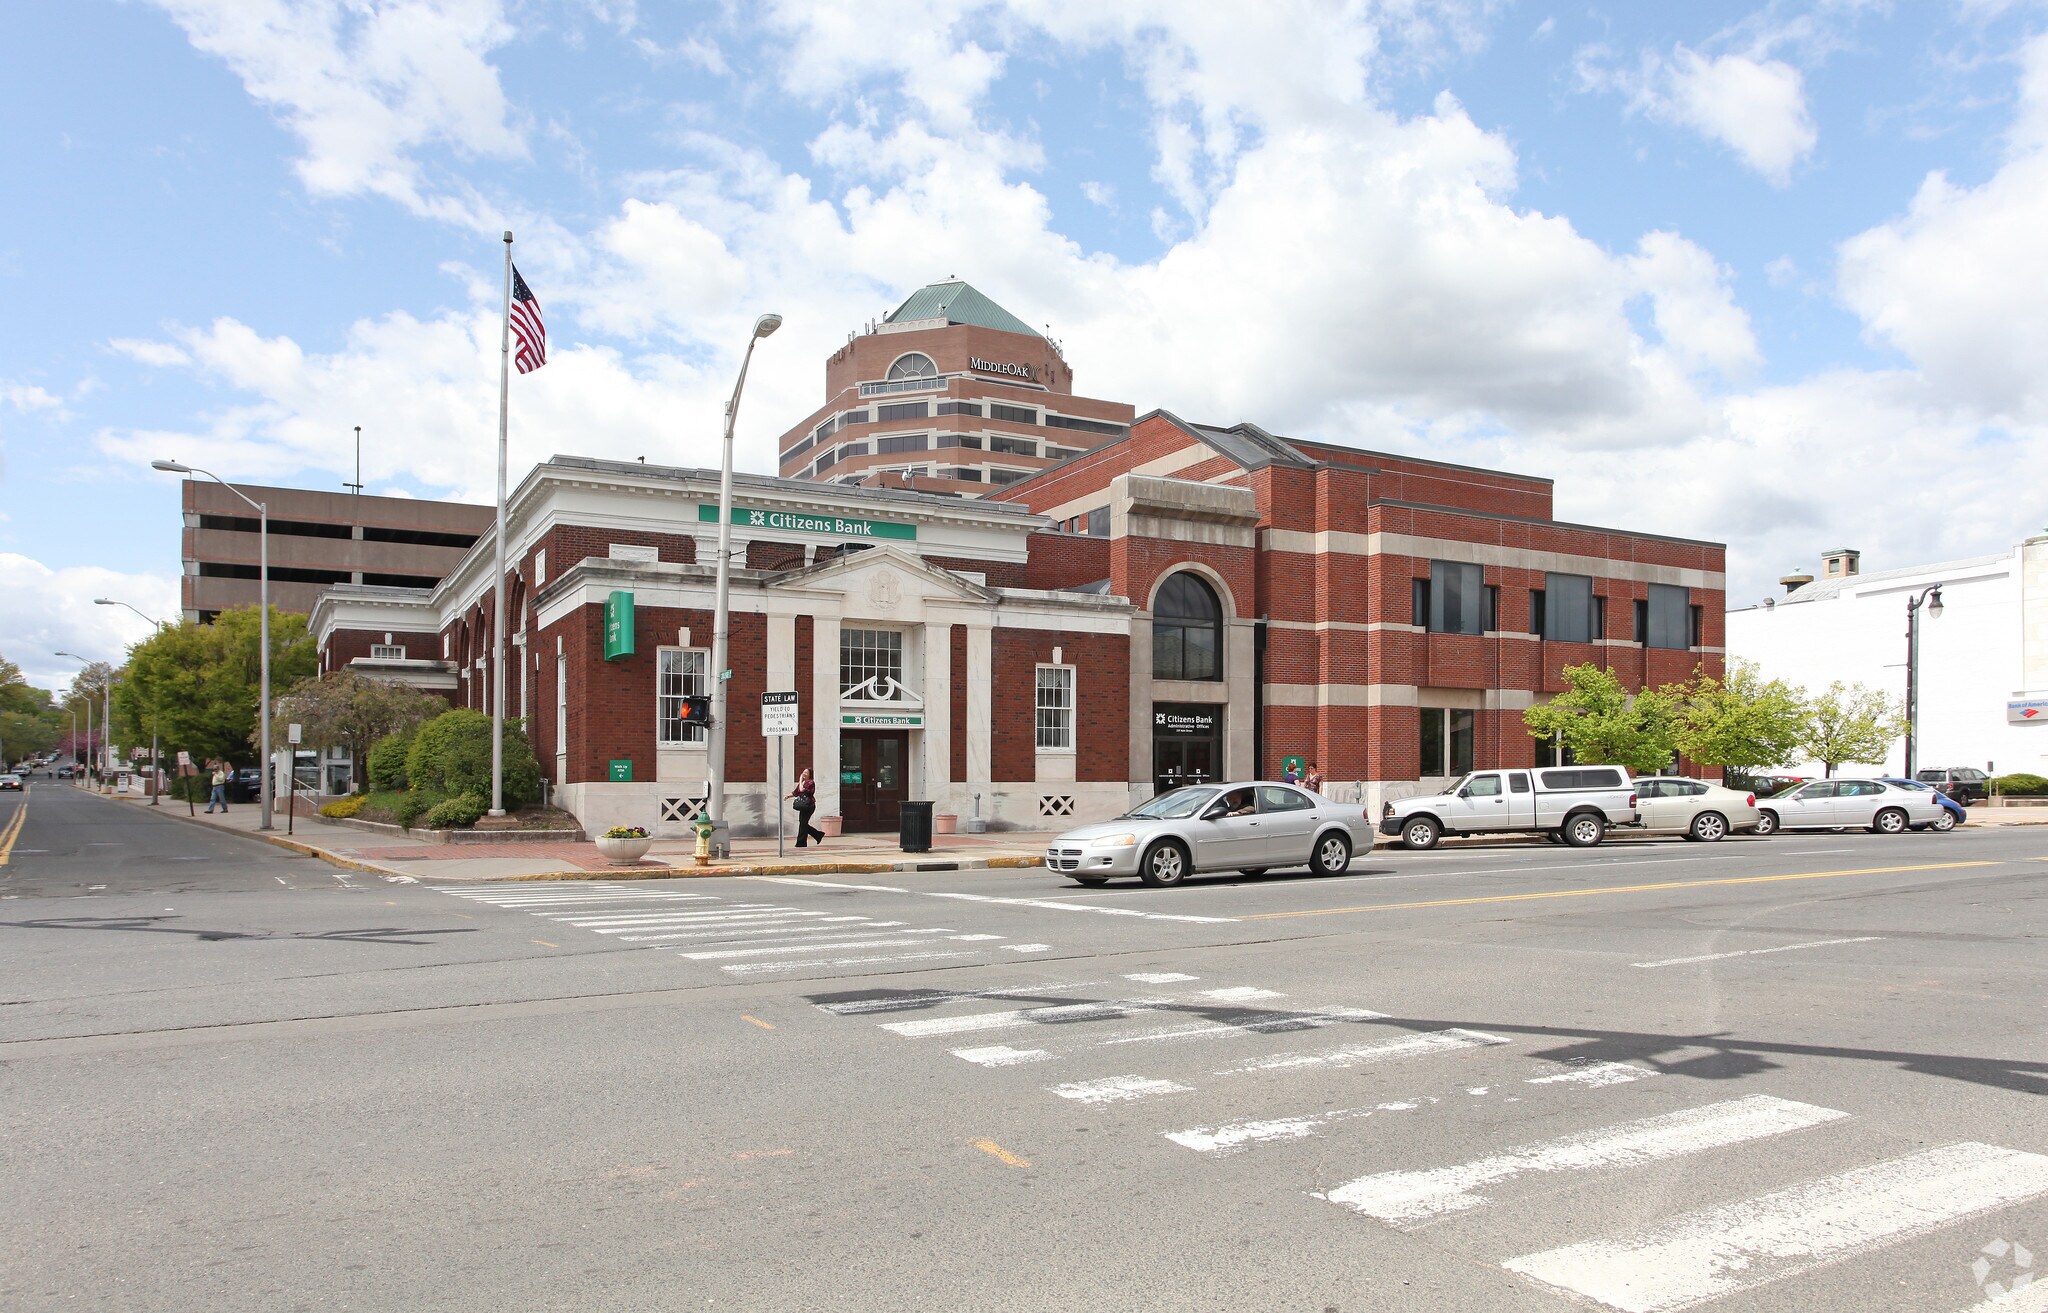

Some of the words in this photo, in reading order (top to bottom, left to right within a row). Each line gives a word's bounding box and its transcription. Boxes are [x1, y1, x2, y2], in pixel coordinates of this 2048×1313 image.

[769, 513, 831, 531] Citizens
[835, 519, 872, 536] Bank
[764, 695, 781, 703] STATE
[863, 716, 891, 724] Citizens
[1168, 715, 1194, 723] Citizens
